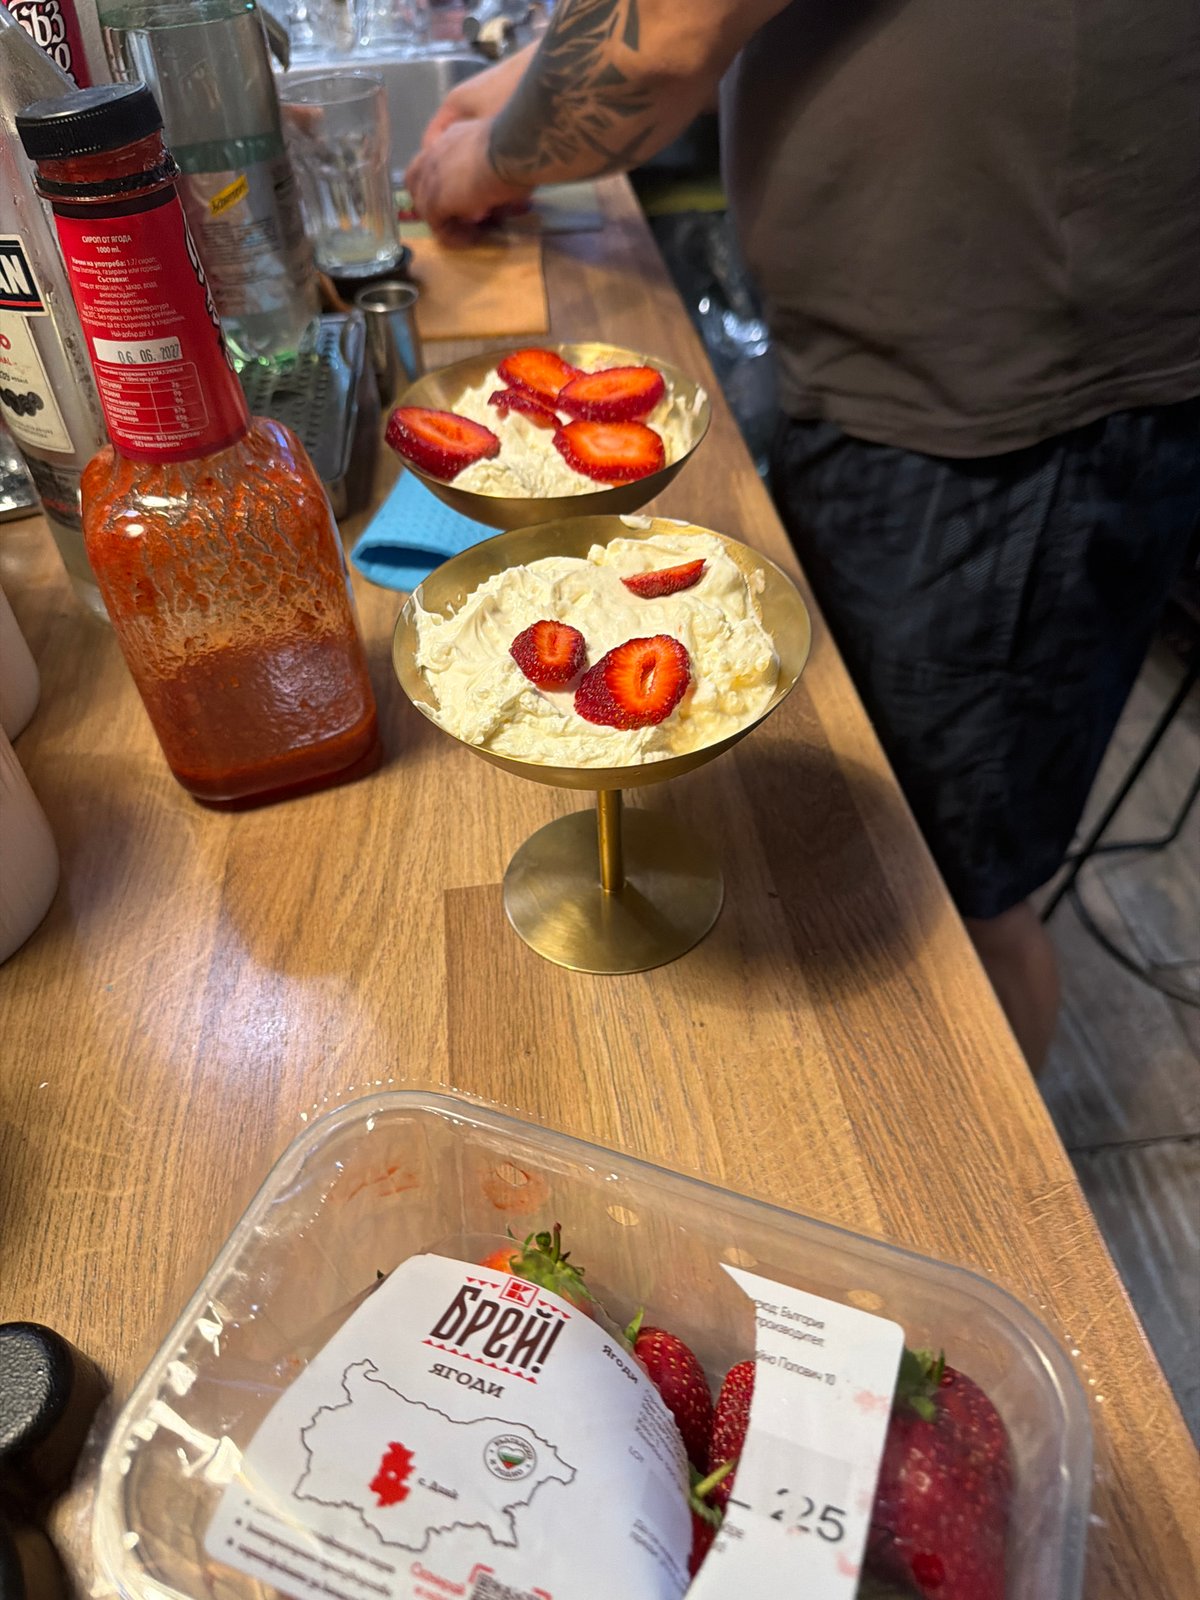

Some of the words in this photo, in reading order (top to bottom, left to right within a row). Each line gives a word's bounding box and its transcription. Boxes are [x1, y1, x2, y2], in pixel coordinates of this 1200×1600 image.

[111, 235, 132, 243] ЯГОДА
[94, 259, 126, 269] употреба:
[97, 275, 129, 283] Съставки:
[139, 349, 156, 362] 06.
[780, 1306, 824, 1330] България
[778, 1355, 823, 1381] Попович
